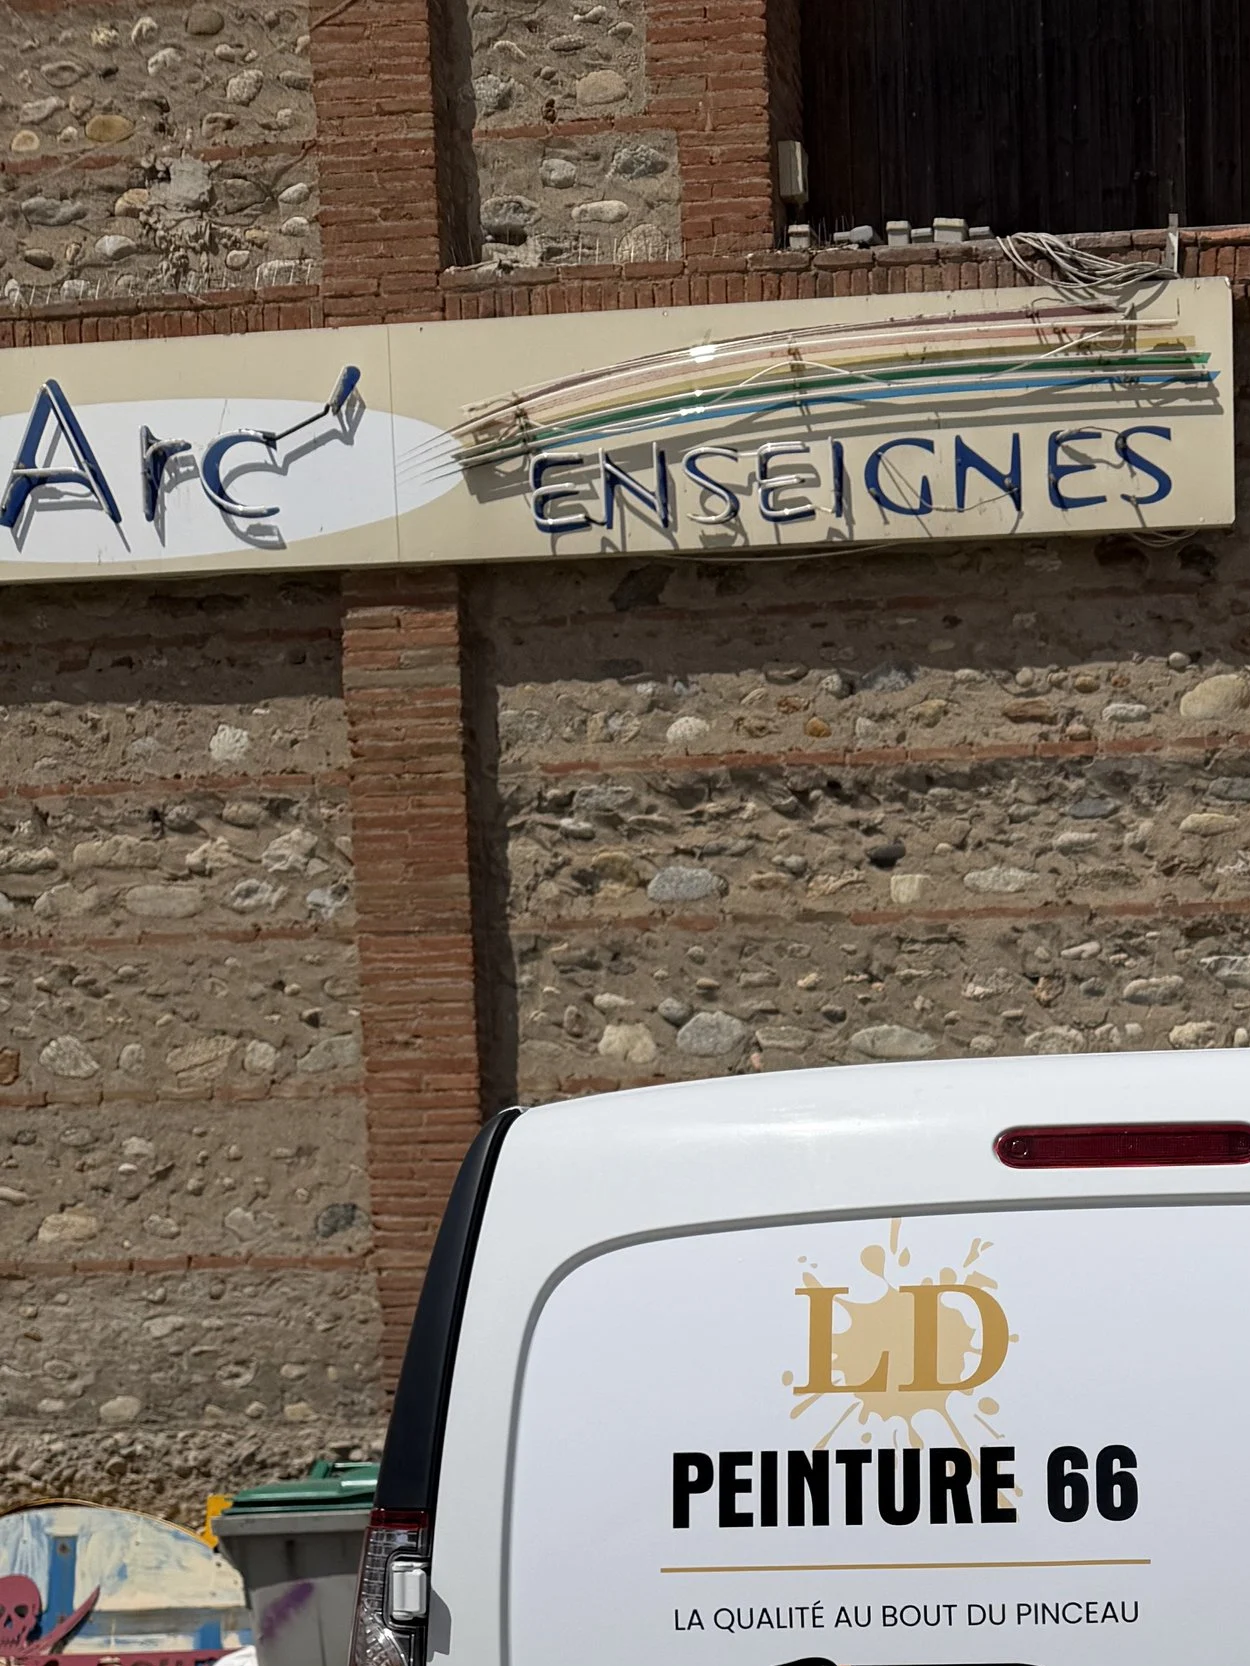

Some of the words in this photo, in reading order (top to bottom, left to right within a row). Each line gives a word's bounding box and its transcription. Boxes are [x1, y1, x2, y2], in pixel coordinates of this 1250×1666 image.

[530, 426, 1172, 533] ENSEIGNES
[793, 1284, 1009, 1394] LD
[672, 1446, 1018, 1529] PEINTURE
[1046, 1444, 1139, 1523] 66
[673, 1608, 705, 1631] LA
[713, 1600, 825, 1634] QUALITÉ
[834, 1605, 872, 1628] AU
[882, 1604, 958, 1627] BOUT
[967, 1603, 1006, 1626] DU
[1016, 1600, 1139, 1625] PINCEAU
